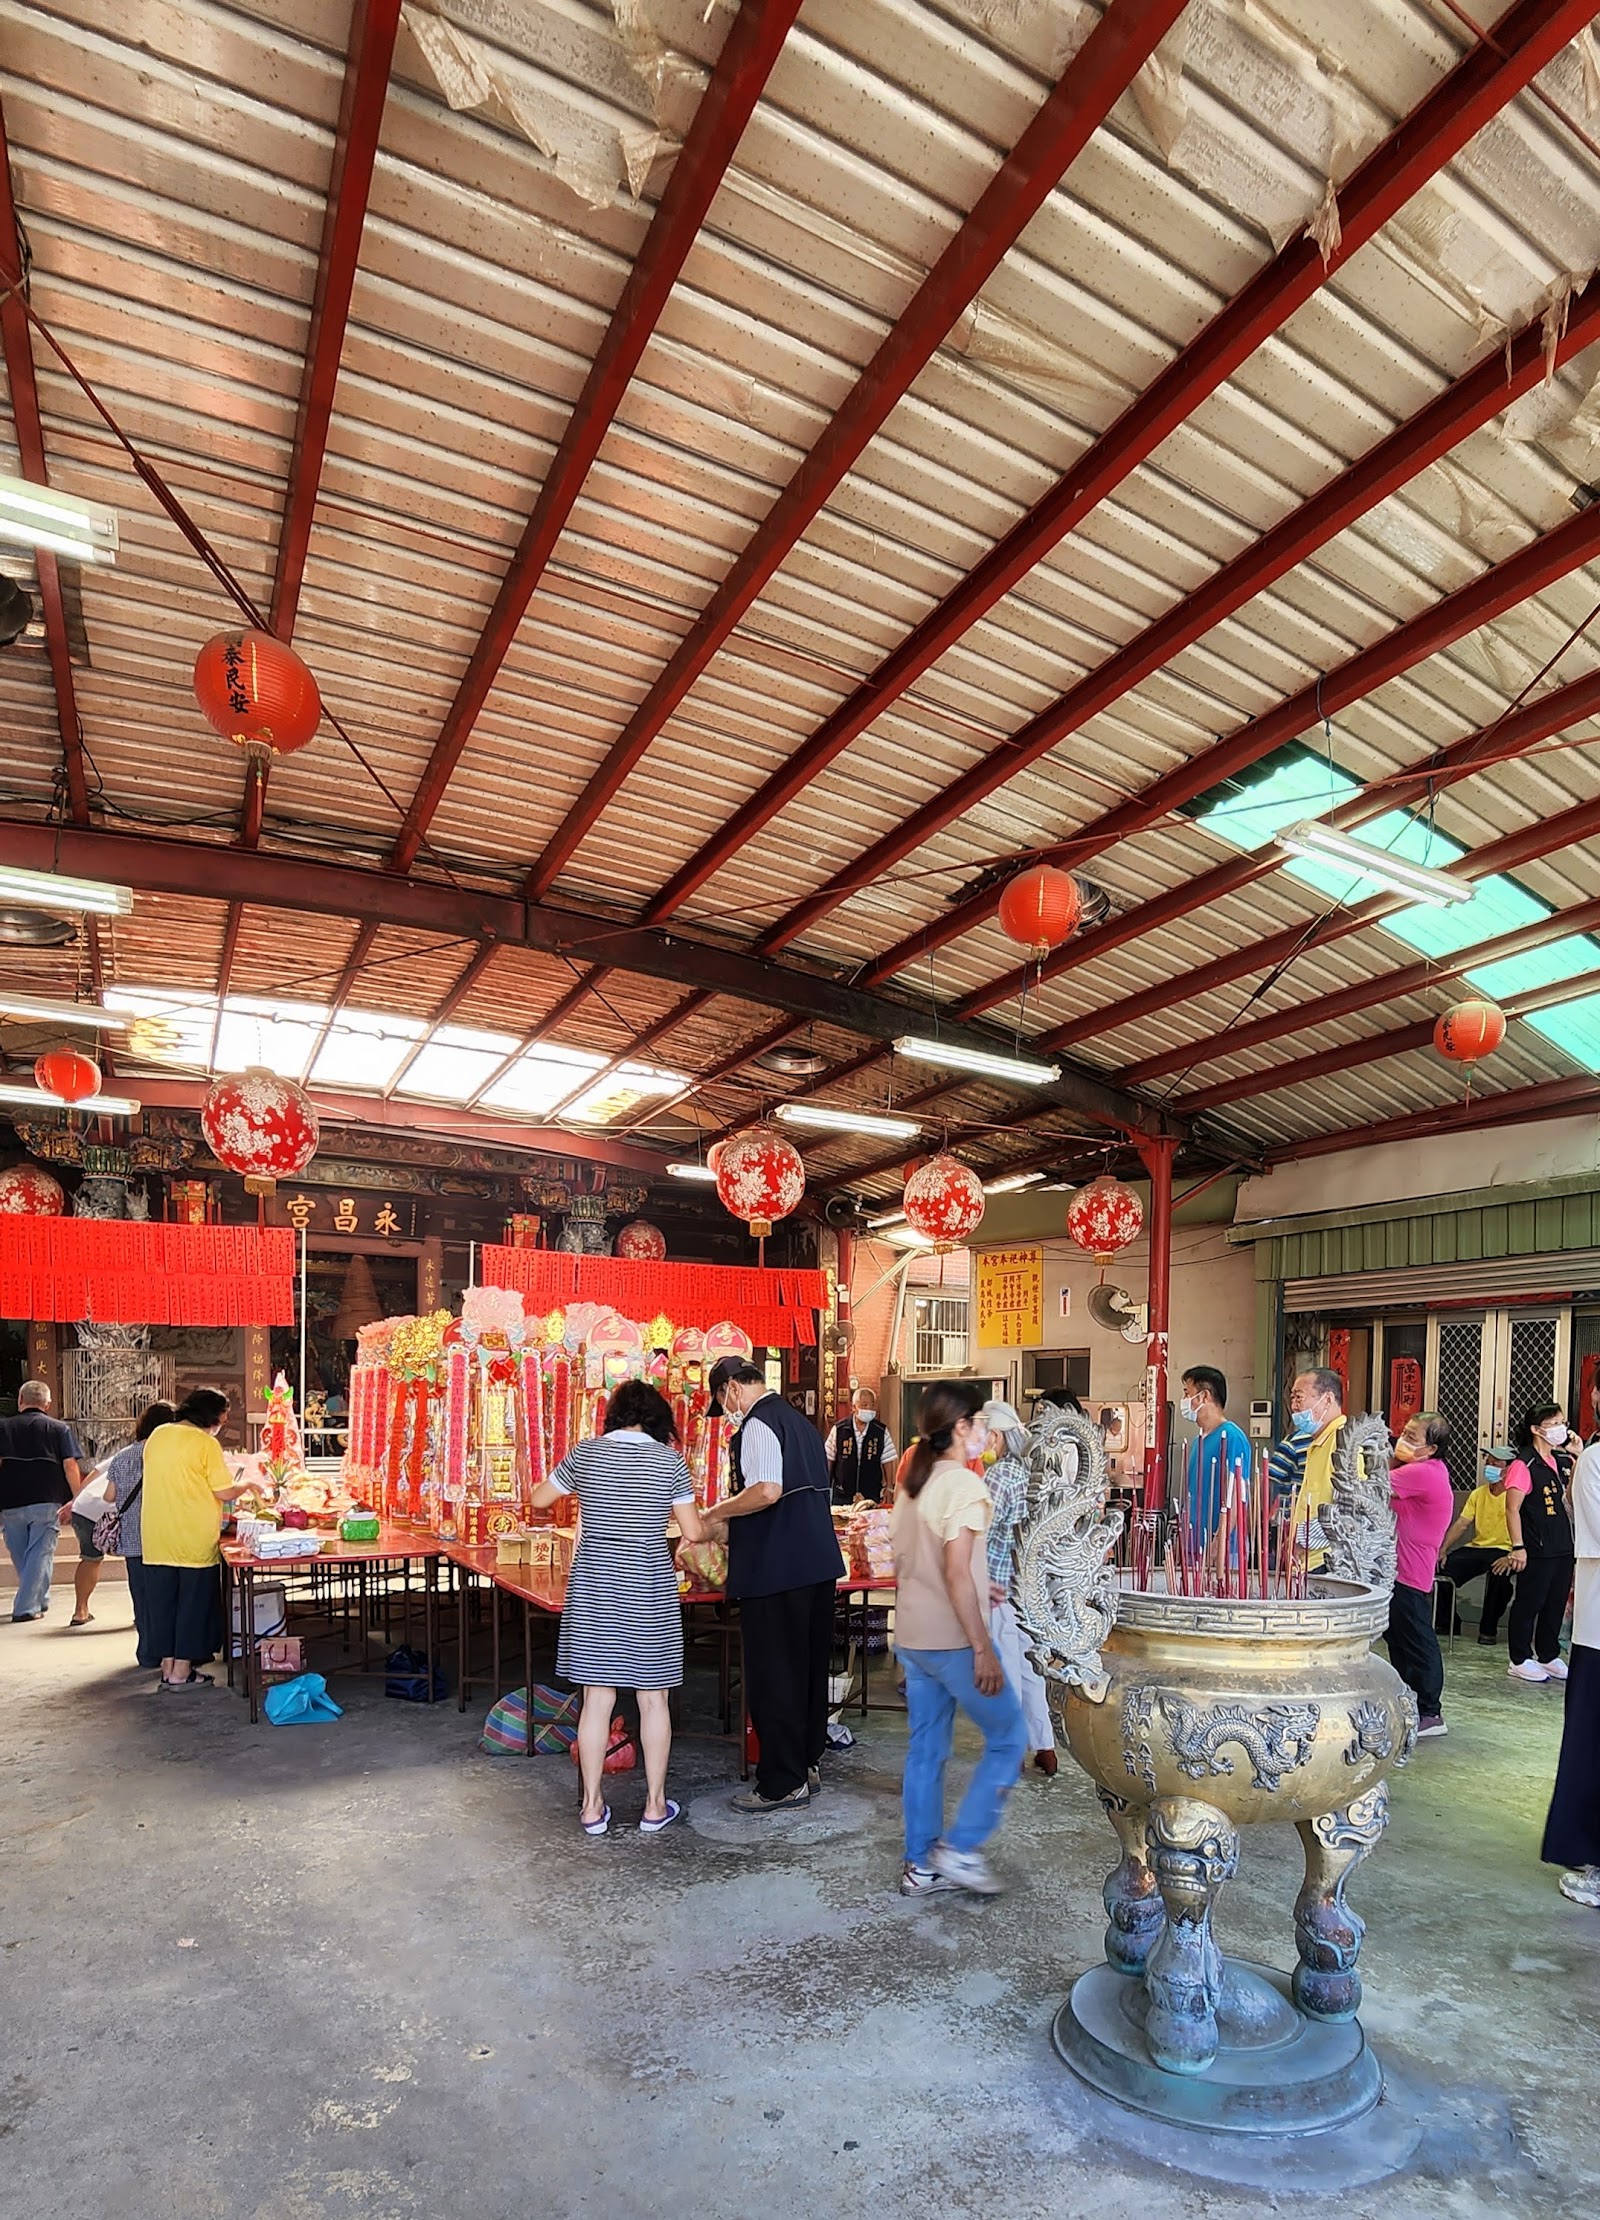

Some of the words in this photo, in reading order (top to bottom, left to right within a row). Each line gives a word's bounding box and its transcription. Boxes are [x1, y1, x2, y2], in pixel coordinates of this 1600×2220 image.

[221, 636, 250, 714] 泰民安
[286, 1194, 402, 1237] 永昌宮
[533, 1542, 550, 1562] 福金
